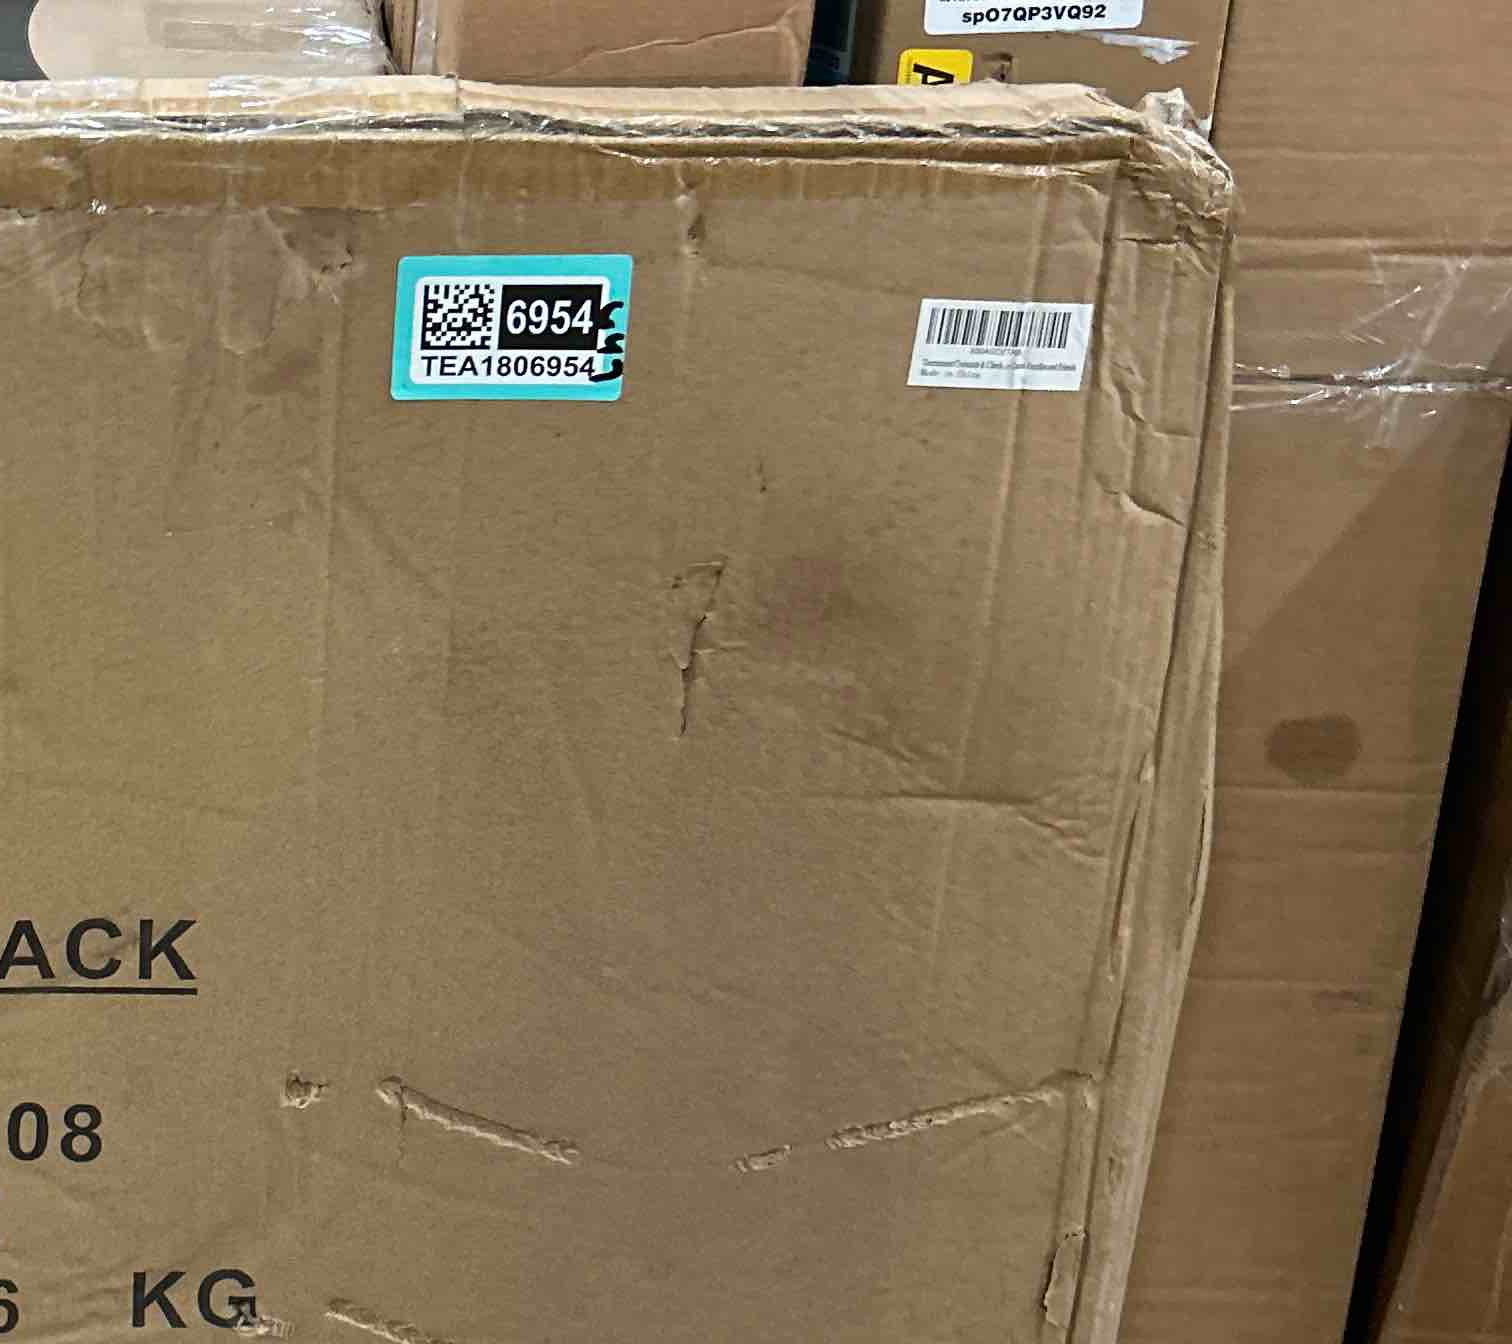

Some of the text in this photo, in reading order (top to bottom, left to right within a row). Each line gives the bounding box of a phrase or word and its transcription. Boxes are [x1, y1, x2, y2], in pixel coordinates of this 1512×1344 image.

[506, 299, 594, 335] 6954
[420, 356, 595, 377] TEA1806954
[131, 1269, 259, 1329] KG
